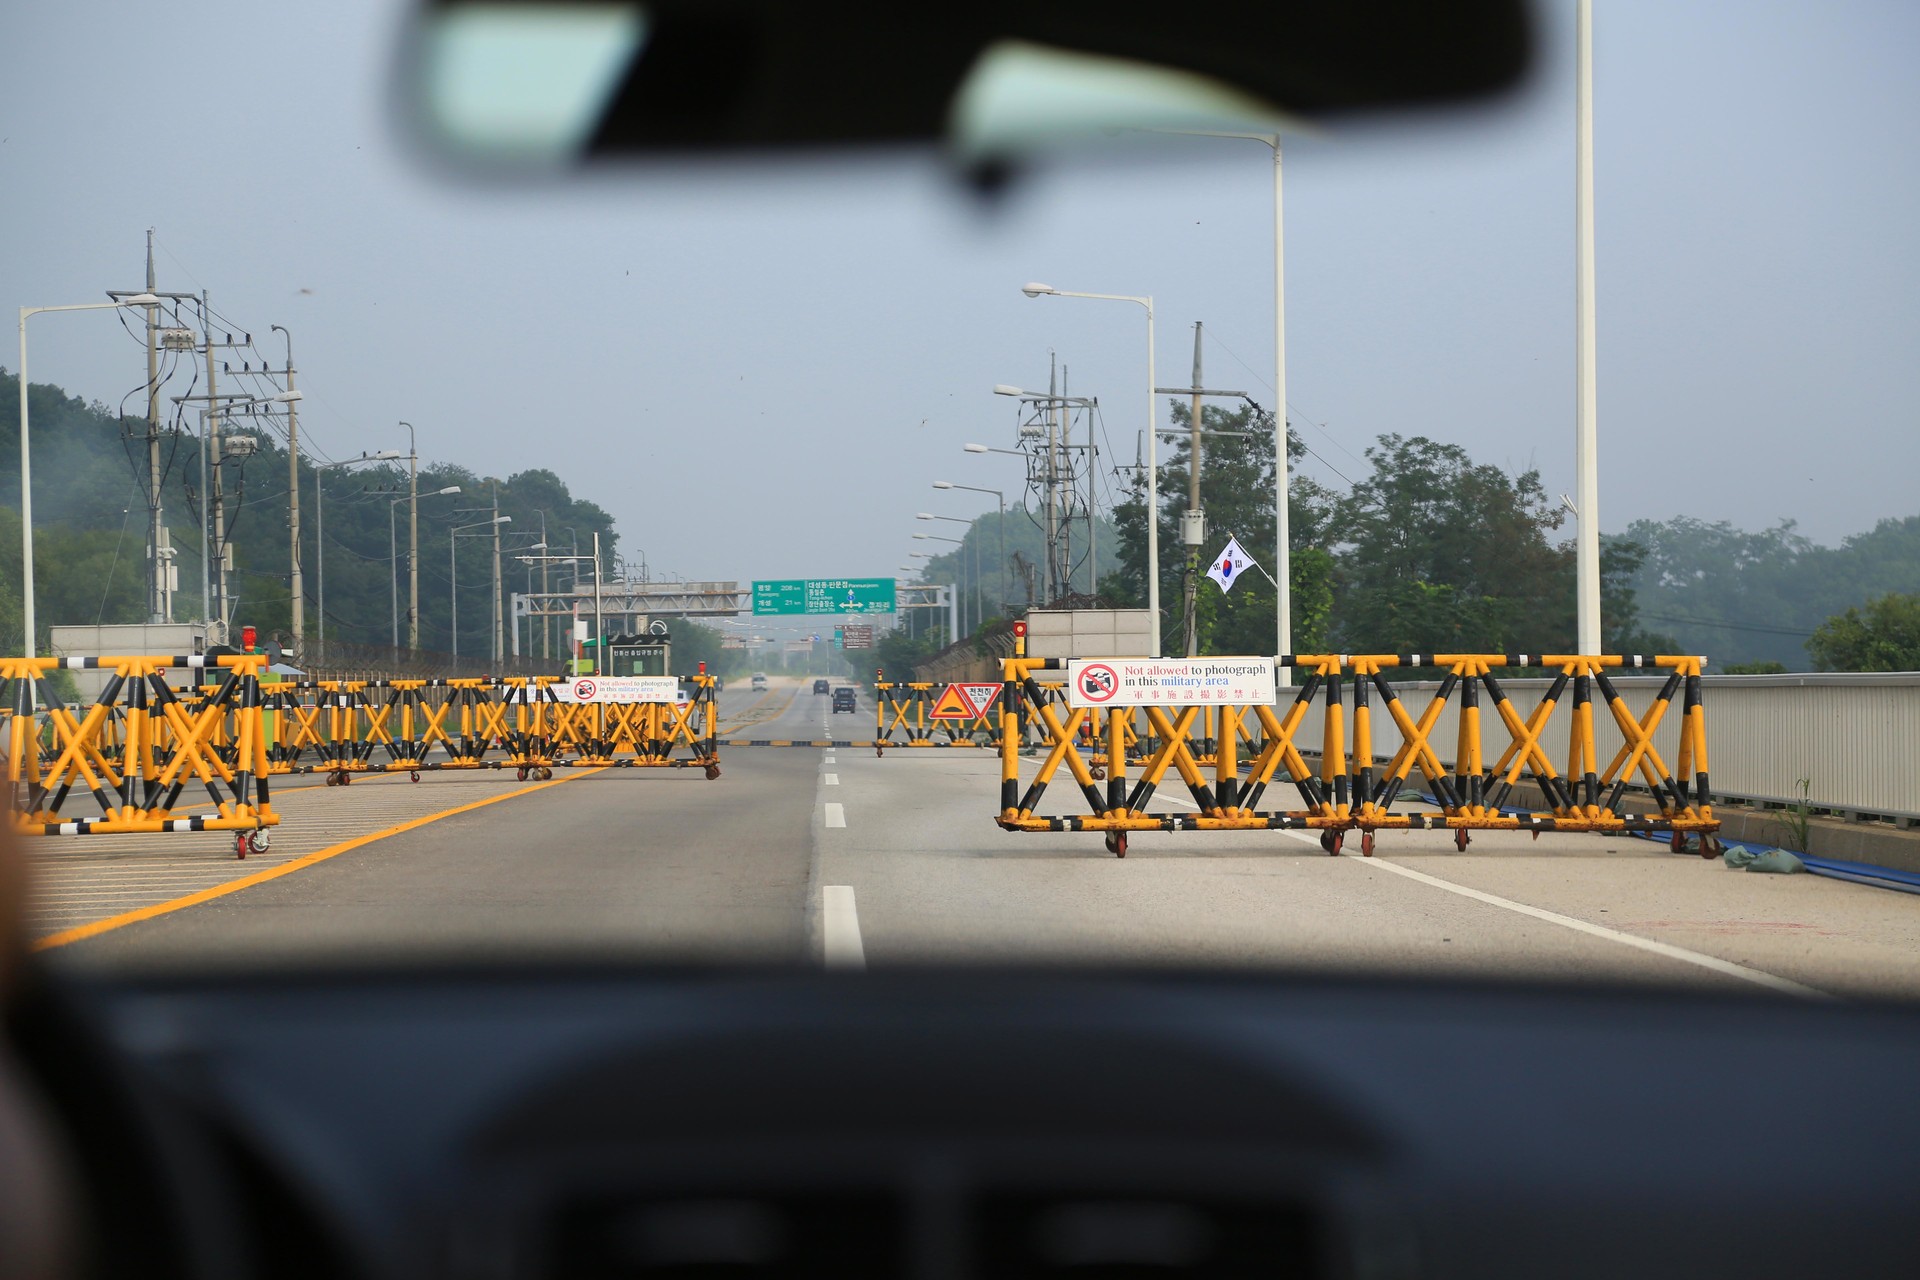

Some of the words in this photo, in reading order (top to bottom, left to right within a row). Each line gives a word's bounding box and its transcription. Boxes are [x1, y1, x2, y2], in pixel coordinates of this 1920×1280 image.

[1125, 665, 1144, 676] Not
[1147, 665, 1188, 676] allowed
[1191, 665, 1202, 675] to
[1205, 664, 1266, 678] photograph
[641, 680, 674, 688] photograph
[1125, 677, 1135, 686] in
[1138, 676, 1158, 686] this
[1161, 675, 1202, 688] military
[1205, 677, 1229, 686] area
[969, 688, 992, 696] 천천히
